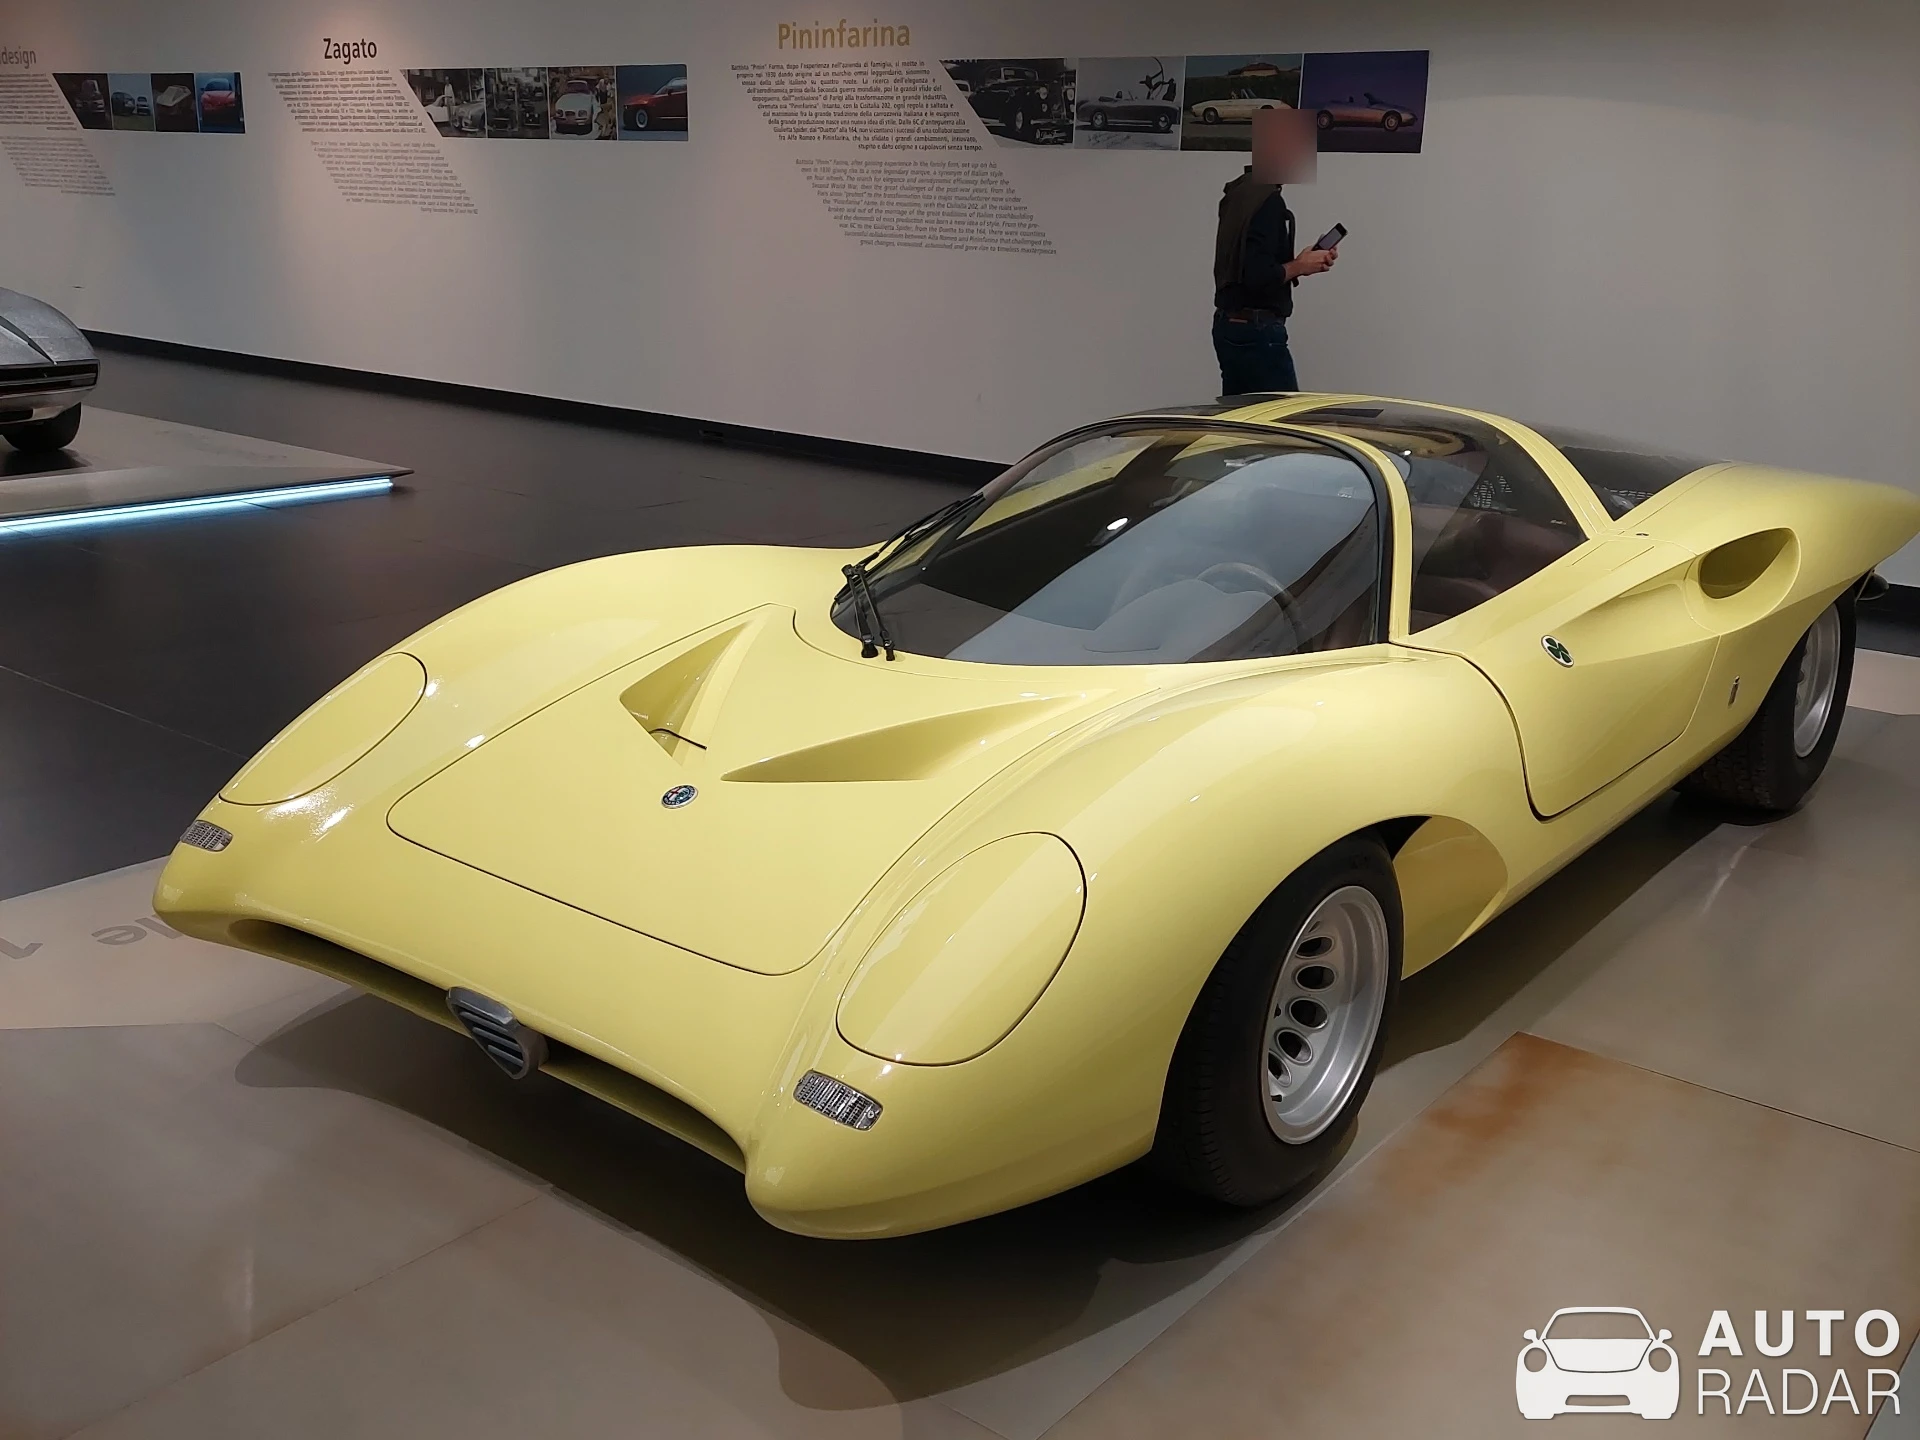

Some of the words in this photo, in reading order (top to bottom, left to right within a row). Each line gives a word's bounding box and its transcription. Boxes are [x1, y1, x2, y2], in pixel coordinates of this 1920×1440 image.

[777, 18, 910, 50] Pininfarina
[0, 45, 37, 69] design
[322, 37, 378, 65] Zagato
